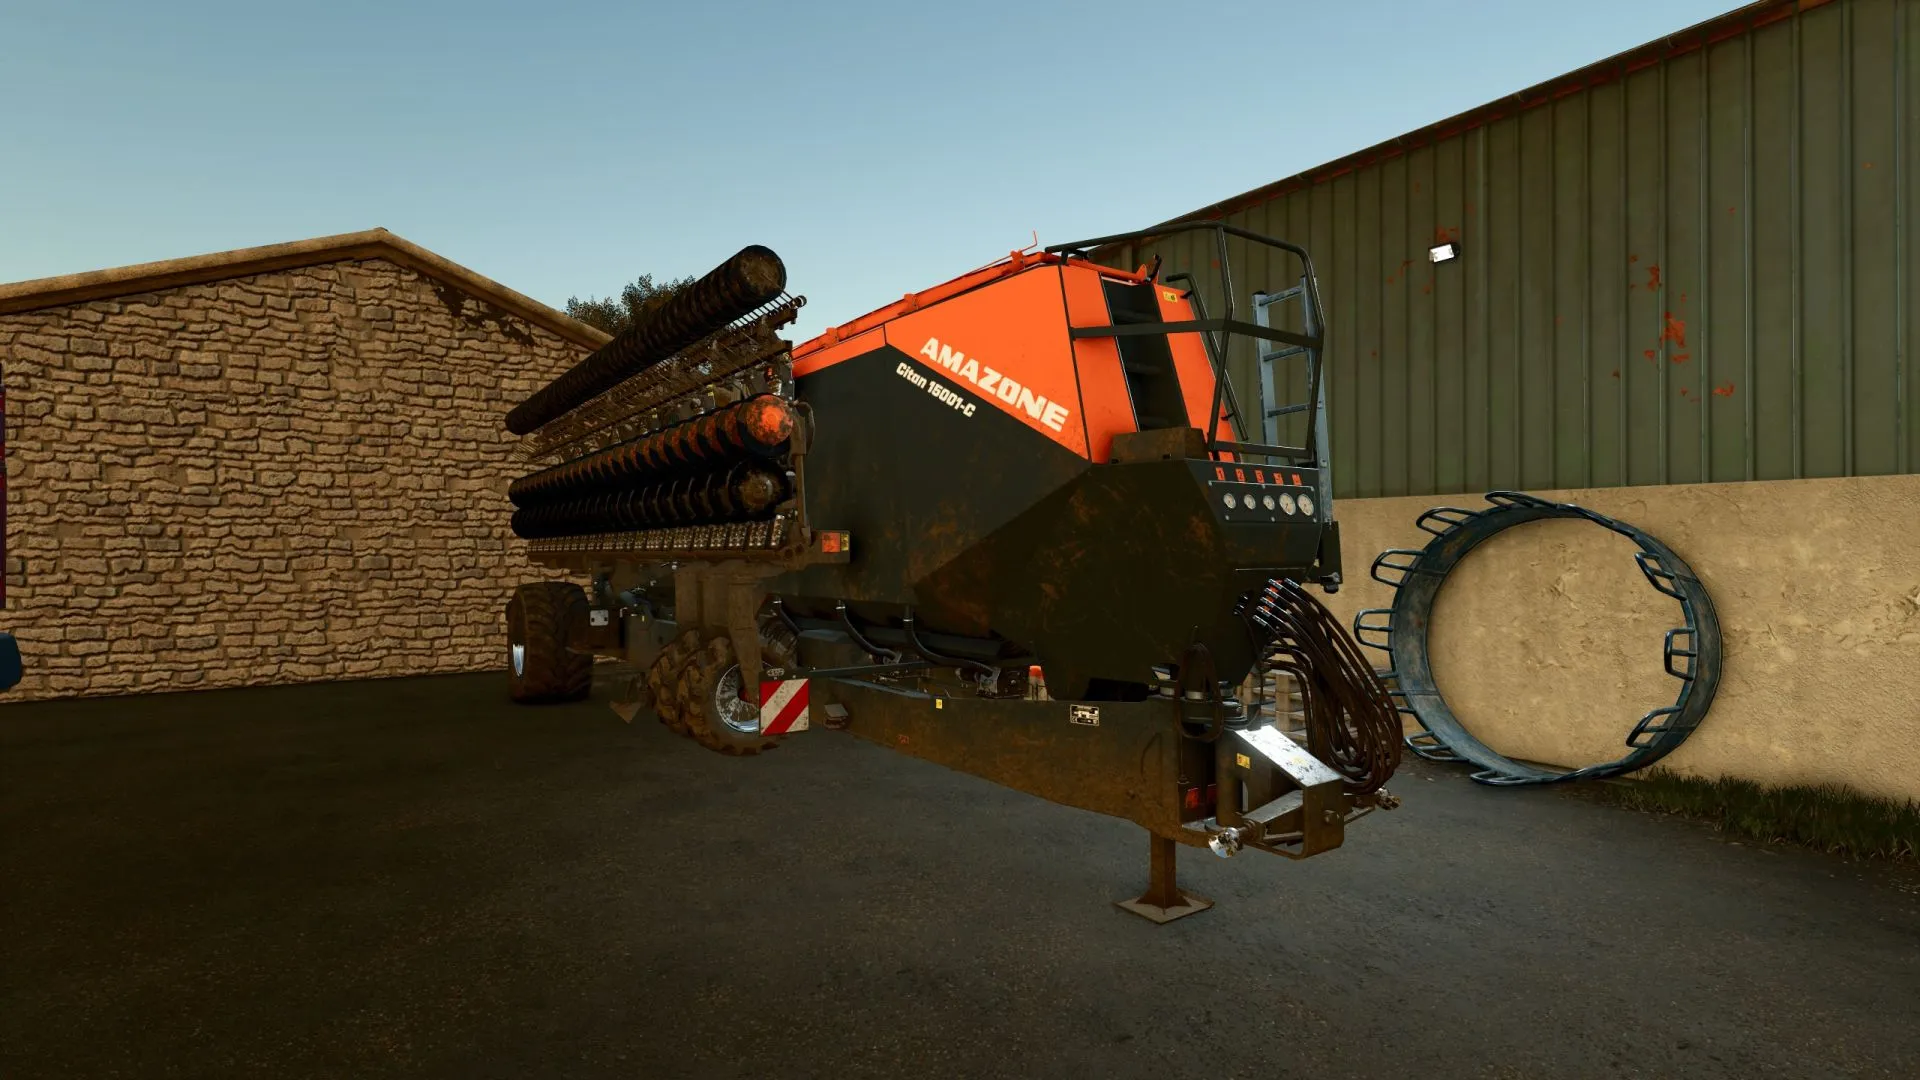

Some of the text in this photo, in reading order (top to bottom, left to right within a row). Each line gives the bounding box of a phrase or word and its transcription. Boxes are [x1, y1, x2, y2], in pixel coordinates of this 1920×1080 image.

[896, 362, 976, 418] Citan 15001-C
[920, 337, 1069, 432] AMAZONE
